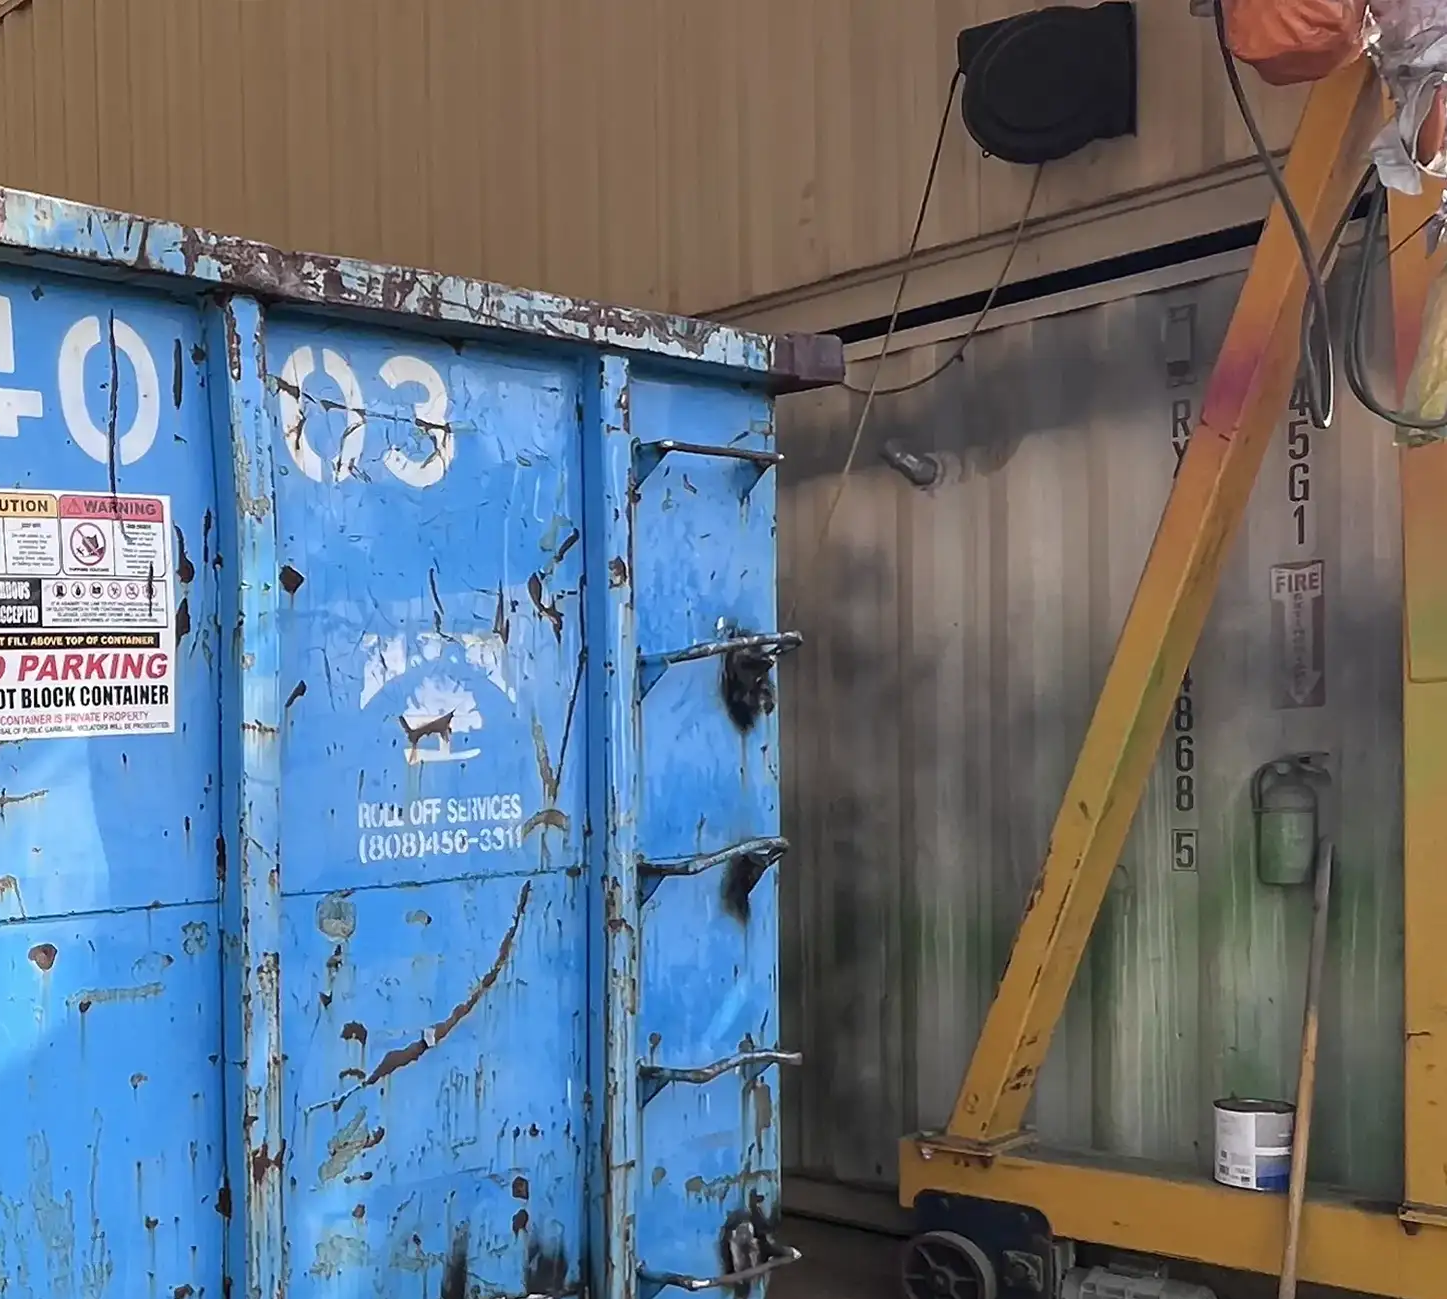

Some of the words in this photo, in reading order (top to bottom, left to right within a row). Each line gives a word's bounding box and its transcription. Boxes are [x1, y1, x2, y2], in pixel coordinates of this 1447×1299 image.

[280, 345, 456, 488] 03
[84, 500, 157, 515] WARNING
[1276, 571, 1320, 594] FIRE
[7, 636, 28, 646] FILL
[30, 636, 64, 646] ABOVE
[65, 636, 85, 646] TOP
[86, 636, 99, 646] OF
[101, 635, 155, 646] CONTAINER
[17, 653, 168, 682] PARKING
[21, 686, 77, 709] BLOCK
[80, 685, 169, 707] CONTAINER
[0, 714, 52, 726] CONTAINER
[54, 713, 63, 723] IS
[64, 712, 100, 723] PRIVATE
[102, 711, 149, 721] PROPERTY
[358, 801, 404, 829] ROLL
[409, 797, 442, 825] OFF
[447, 792, 522, 824] SERVICES
[1175, 832, 1195, 869] 5
